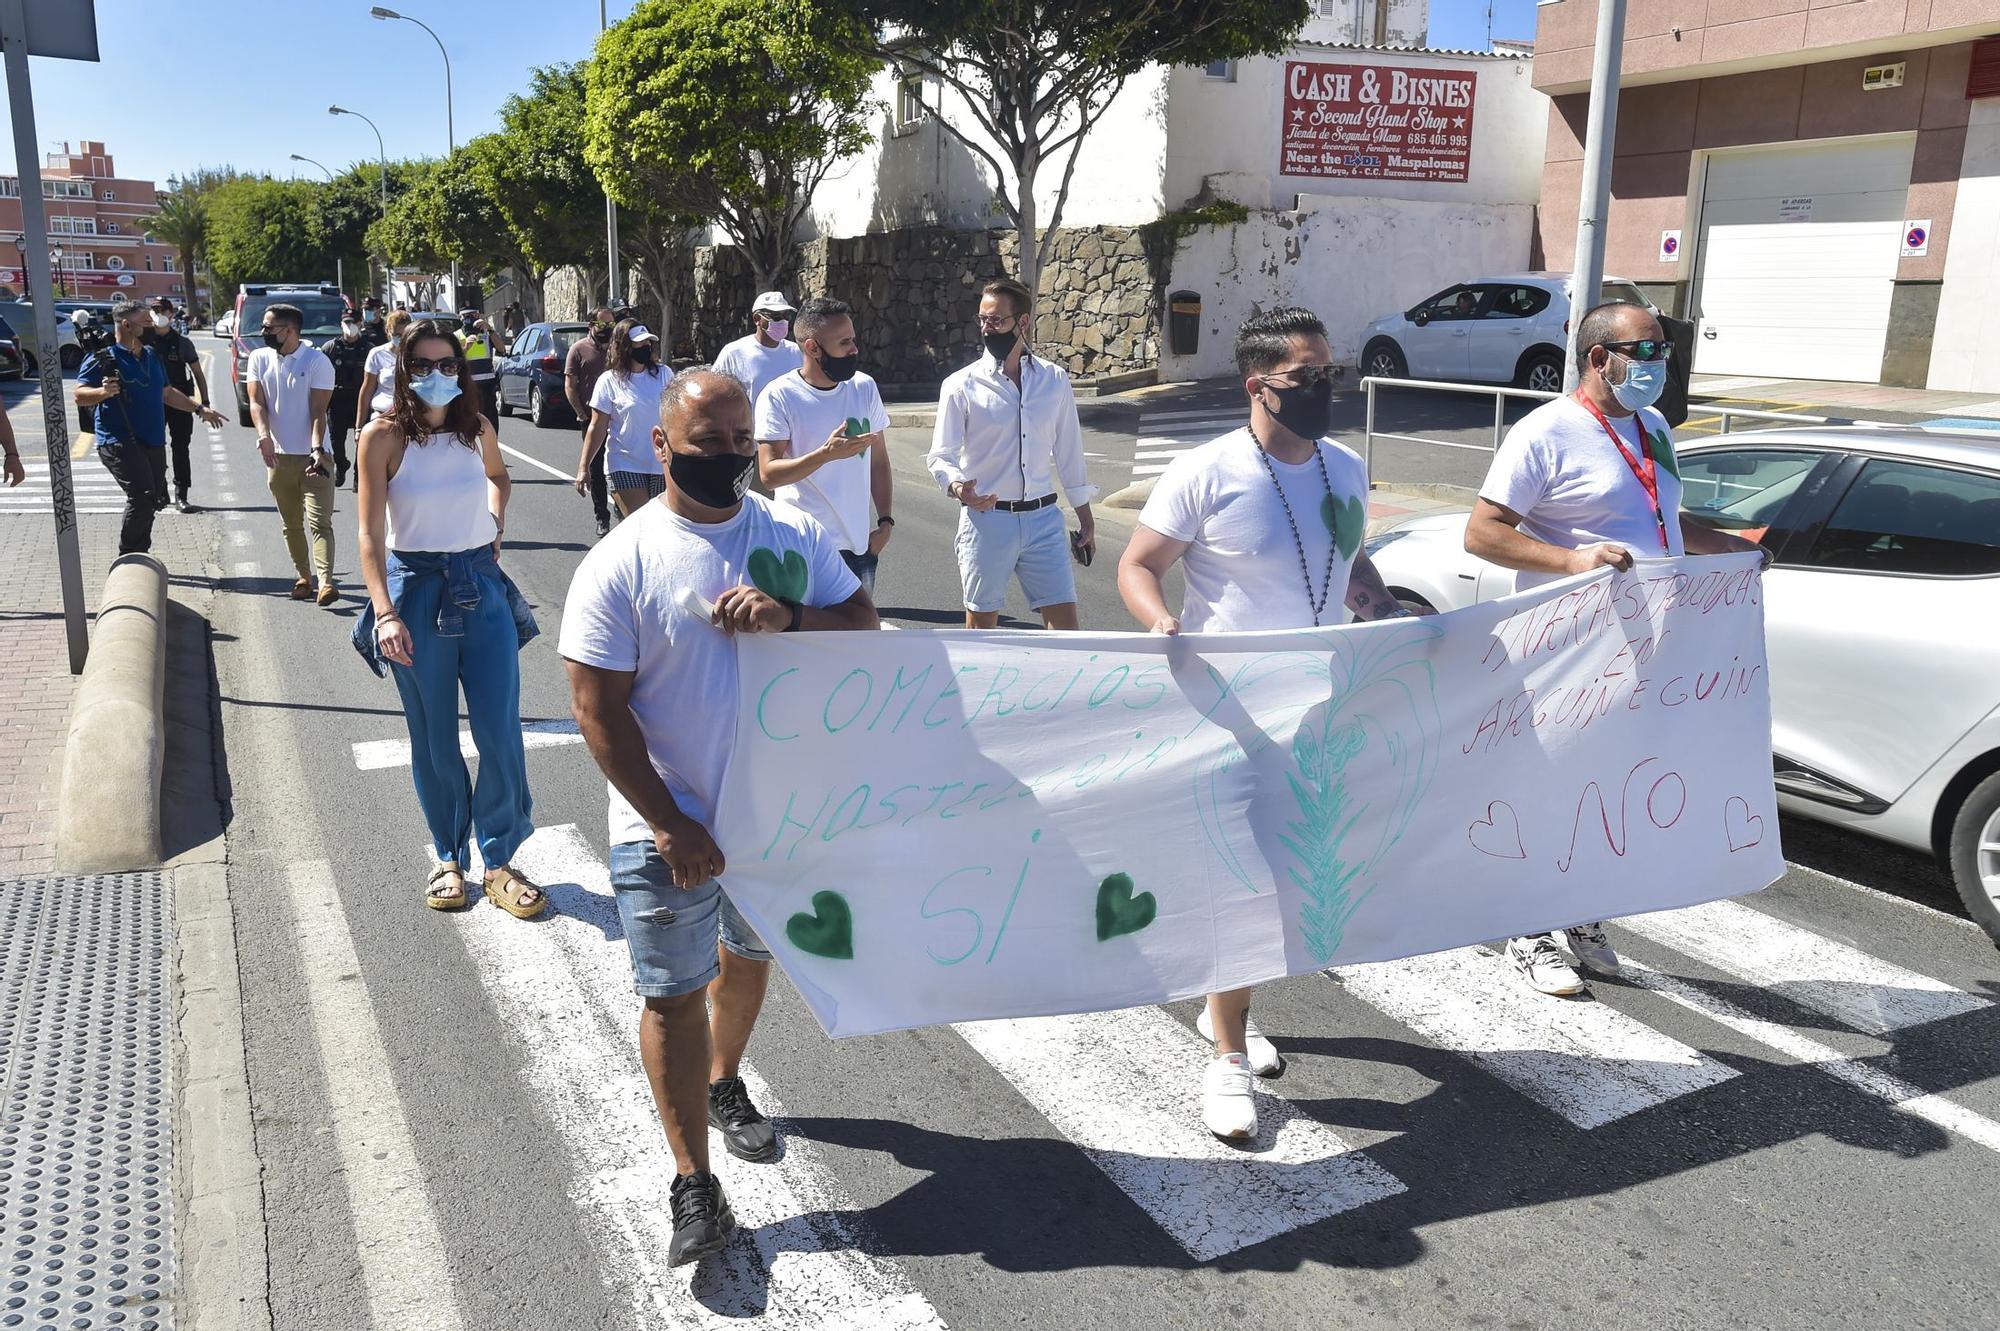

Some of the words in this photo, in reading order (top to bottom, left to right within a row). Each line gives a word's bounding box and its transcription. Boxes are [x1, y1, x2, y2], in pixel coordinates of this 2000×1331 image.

[1290, 65, 1351, 101] CASH
[1359, 69, 1381, 103] &
[1390, 71, 1472, 107] BISNES
[1309, 101, 1364, 126] Second
[1366, 104, 1410, 128] Hand
[1411, 107, 1448, 133] Shop
[1286, 123, 1316, 139] Tienda
[1319, 127, 1329, 139] de
[1331, 126, 1371, 143] Segunda
[1372, 128, 1402, 143] Mano
[1407, 133, 1426, 144] 685
[1429, 134, 1447, 145] 405
[1449, 135, 1467, 146] 995
[1285, 164, 1309, 173] Avda.
[1311, 165, 1321, 173] de
[1364, 168, 1381, 176] C.C.
[1438, 170, 1464, 179] Planta
[1286, 150, 1318, 163] Near
[1321, 152, 1341, 164] the
[1388, 155, 1465, 170] Maspalomas
[1604, 631, 1670, 677] EN
[1558, 757, 1686, 873] NO
